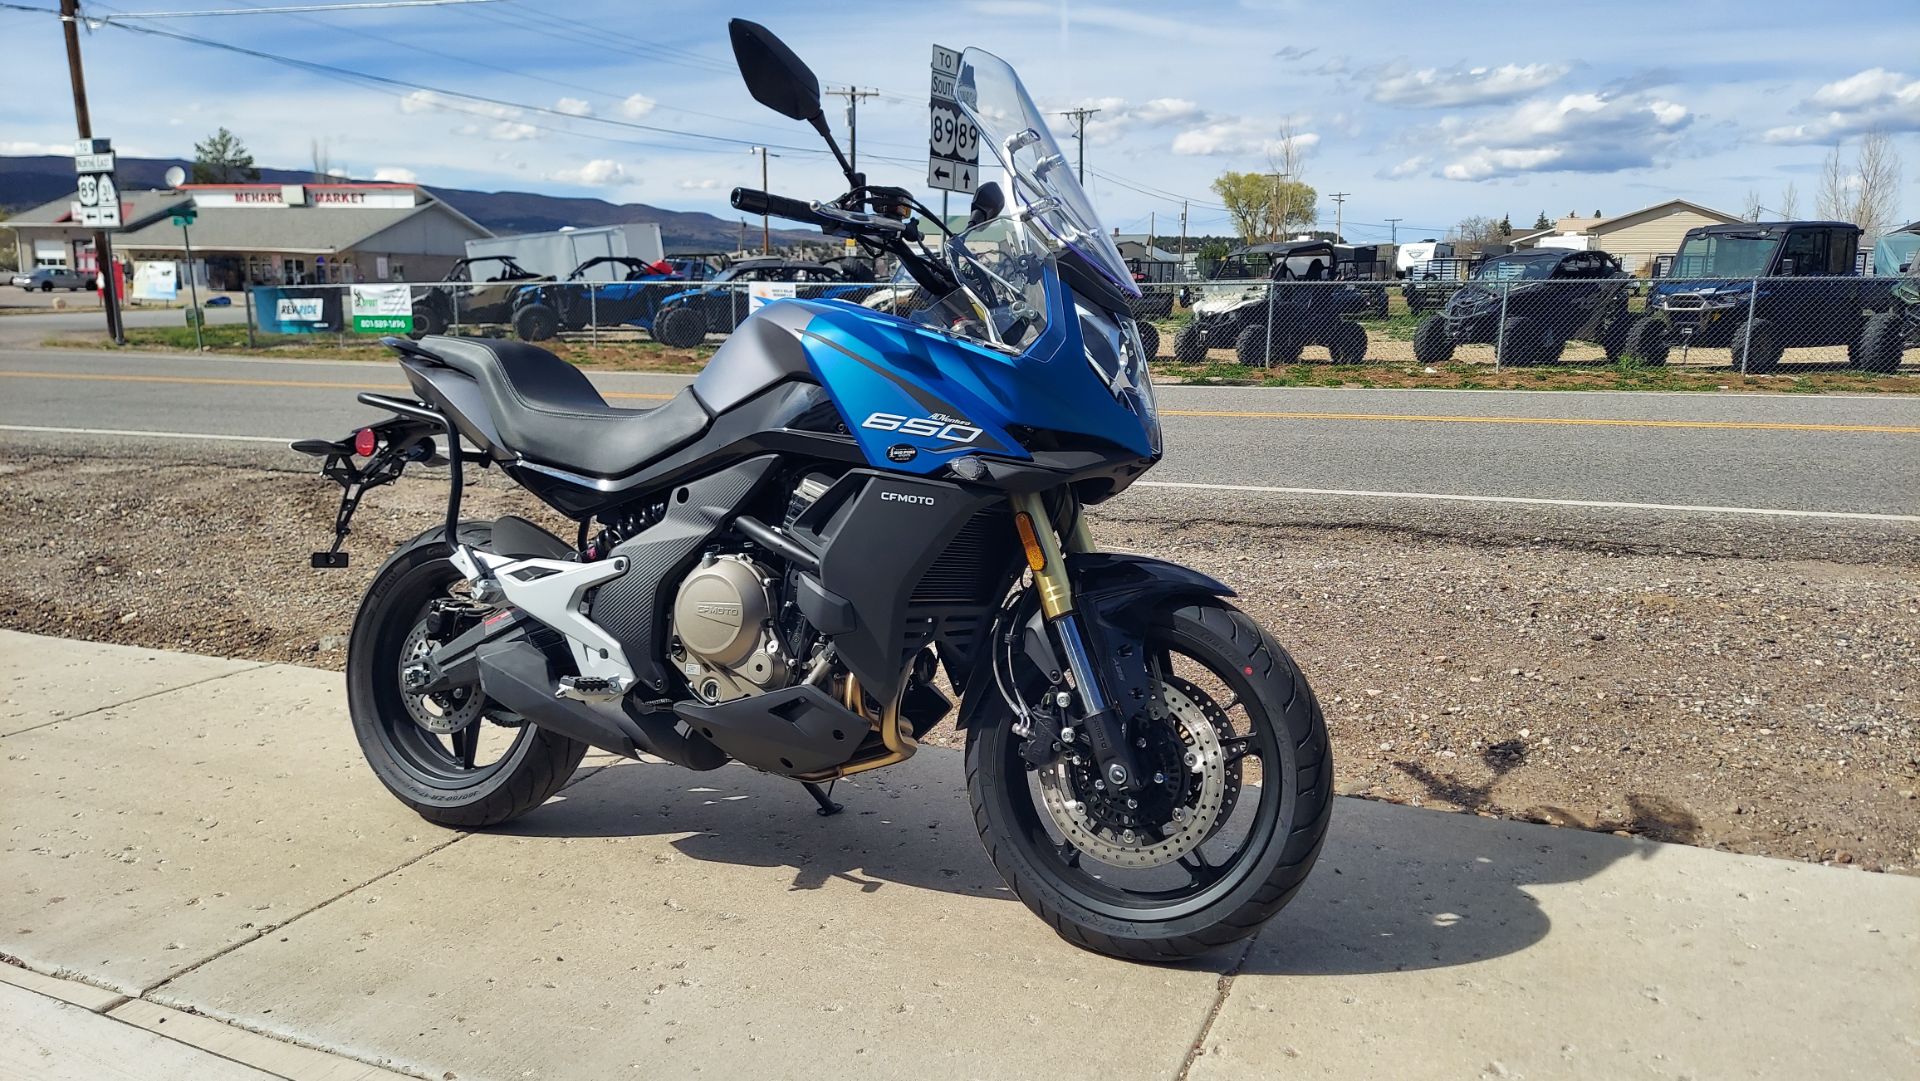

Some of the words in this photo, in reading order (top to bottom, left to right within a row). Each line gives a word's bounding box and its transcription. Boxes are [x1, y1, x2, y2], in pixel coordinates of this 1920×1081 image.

[939, 51, 951, 69] TO
[933, 115, 954, 144] 89
[958, 123, 978, 150] 89
[80, 182, 96, 198] 89
[315, 193, 366, 203] MARKET
[861, 412, 984, 443] 650
[881, 491, 935, 506] CFMOTO
[697, 605, 739, 617] CFMOTO
